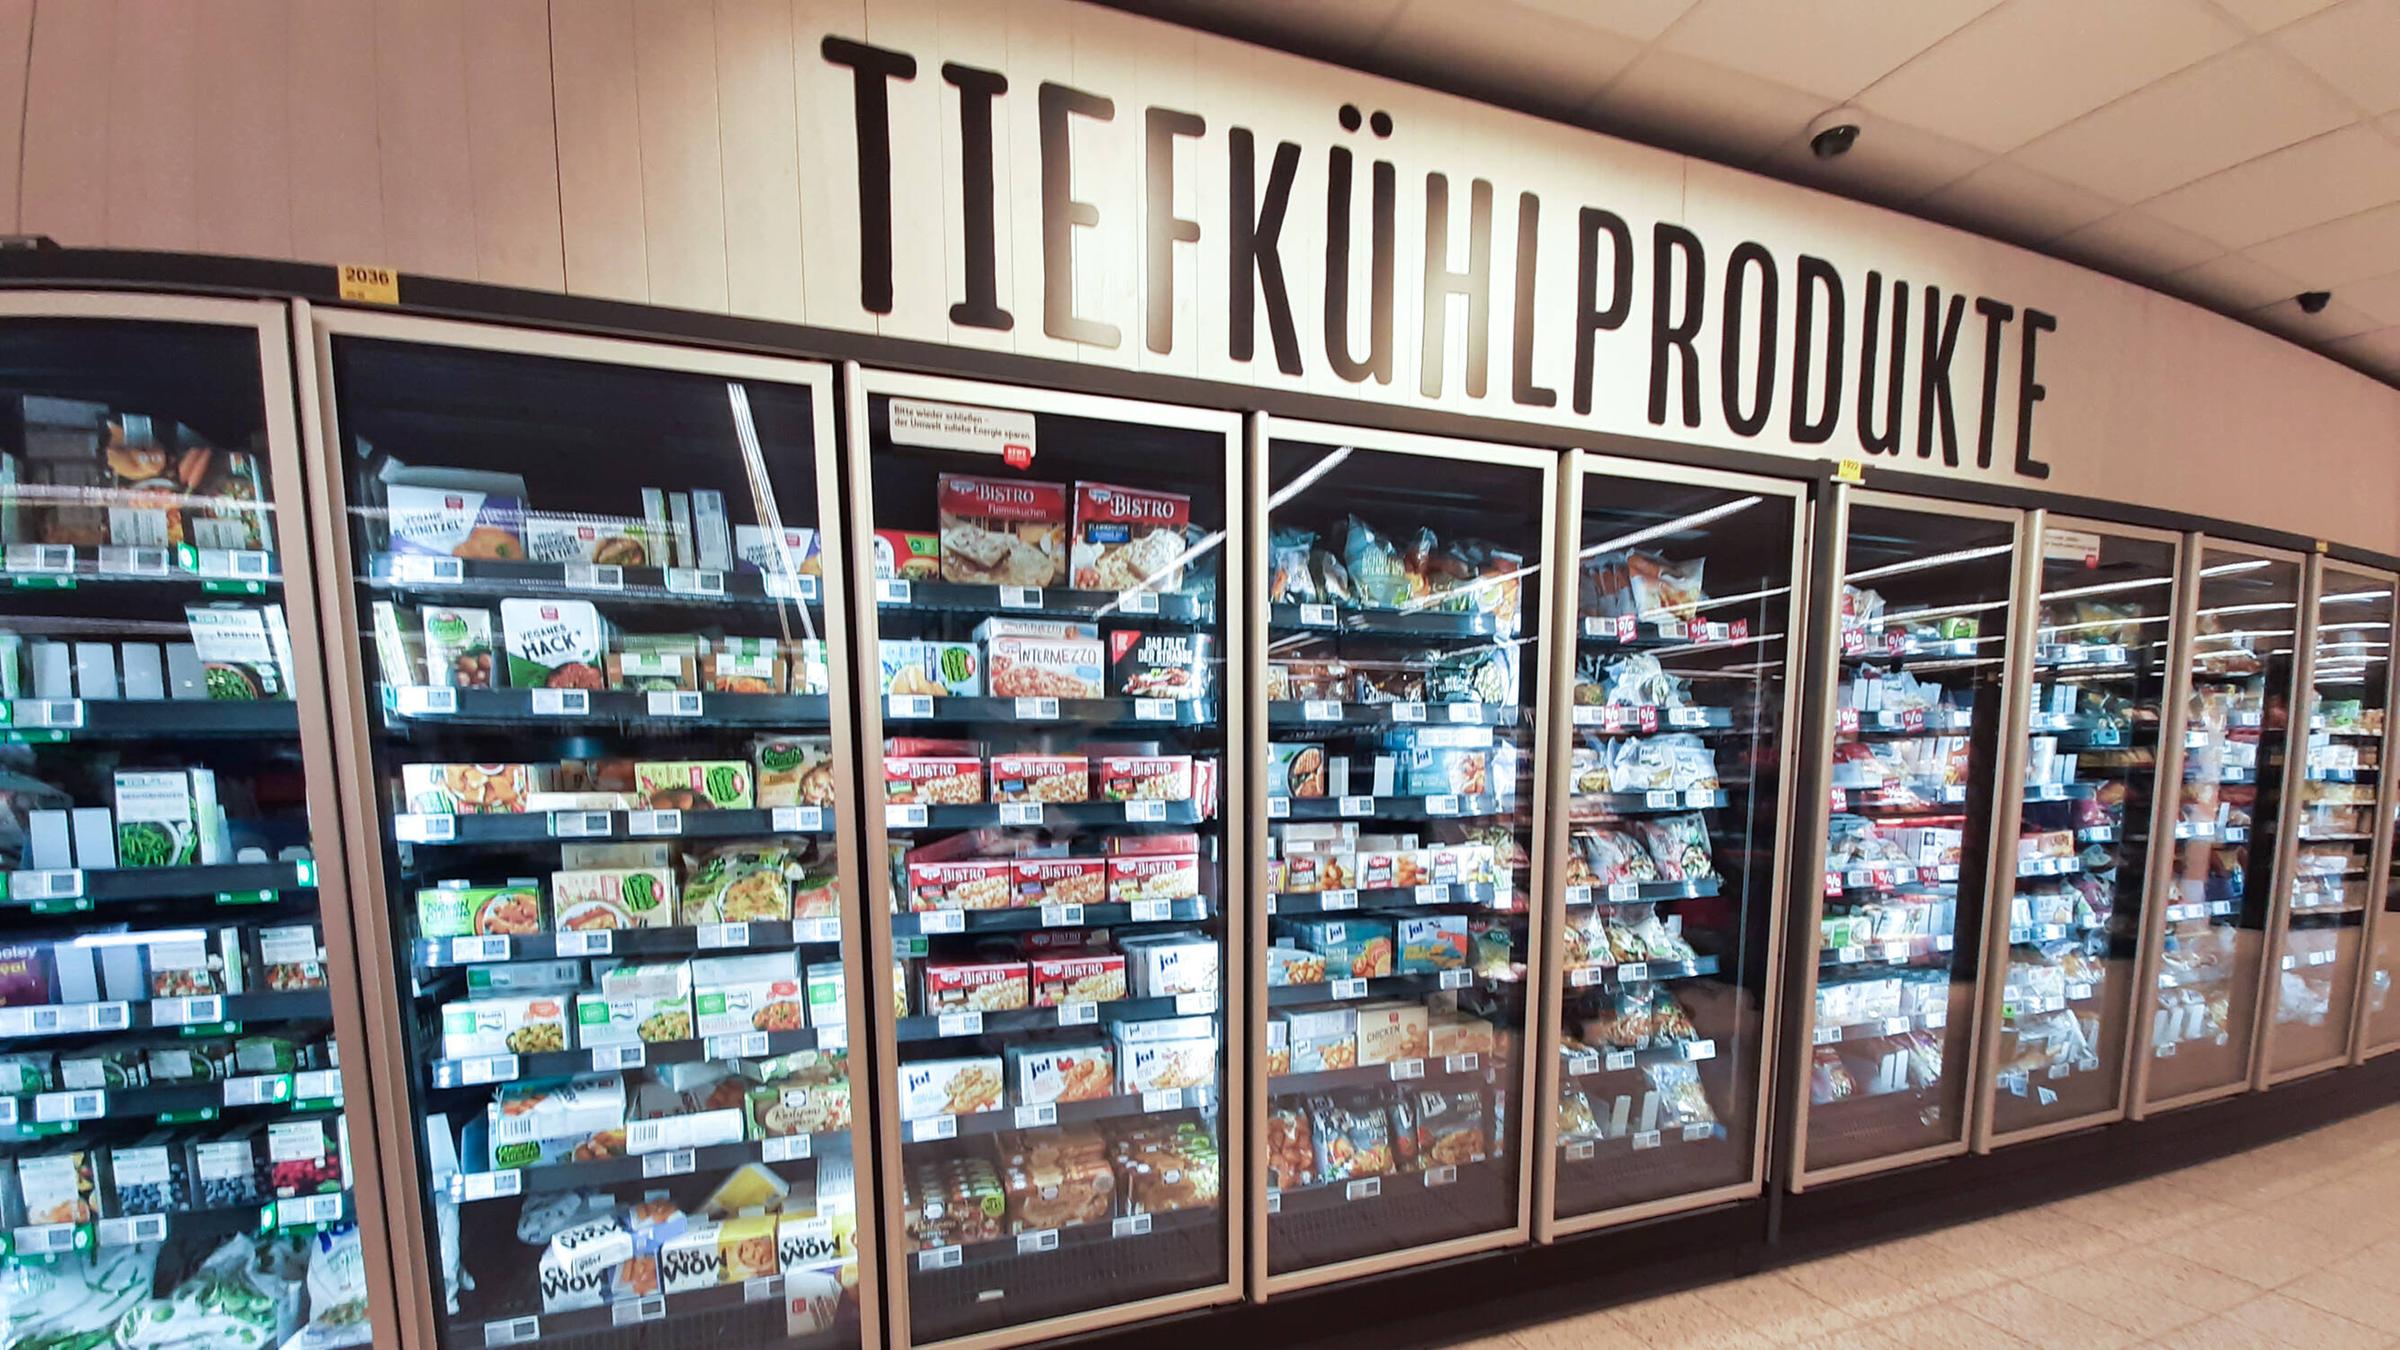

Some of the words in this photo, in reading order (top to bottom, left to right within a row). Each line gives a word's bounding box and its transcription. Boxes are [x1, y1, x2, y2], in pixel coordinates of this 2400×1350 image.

[821, 35, 2058, 480] TIEFKÜHLPRODUKTE
[894, 405, 914, 416] Bitte
[916, 408, 944, 420] wieder
[945, 411, 983, 424] schließen
[894, 419, 908, 428] der
[910, 419, 942, 432] Umwelt
[944, 423, 972, 434] zuliebe
[973, 426, 1002, 440] Energie
[976, 483, 1034, 503] BISTRO
[1110, 493, 1174, 518] BISTRO
[519, 623, 567, 640] VEGANES
[521, 636, 577, 660] HACK
[1017, 642, 1097, 665] INTERMEZZO
[909, 763, 957, 778] BISTRO
[1022, 762, 1066, 778] BISTRO
[1130, 761, 1172, 777] BISTRO
[940, 867, 986, 883] BISTRO
[1039, 864, 1083, 880] BISTRO
[1135, 861, 1177, 877] BISTRO
[961, 970, 1006, 986] BISTRO
[1062, 963, 1104, 979] BISTRO
